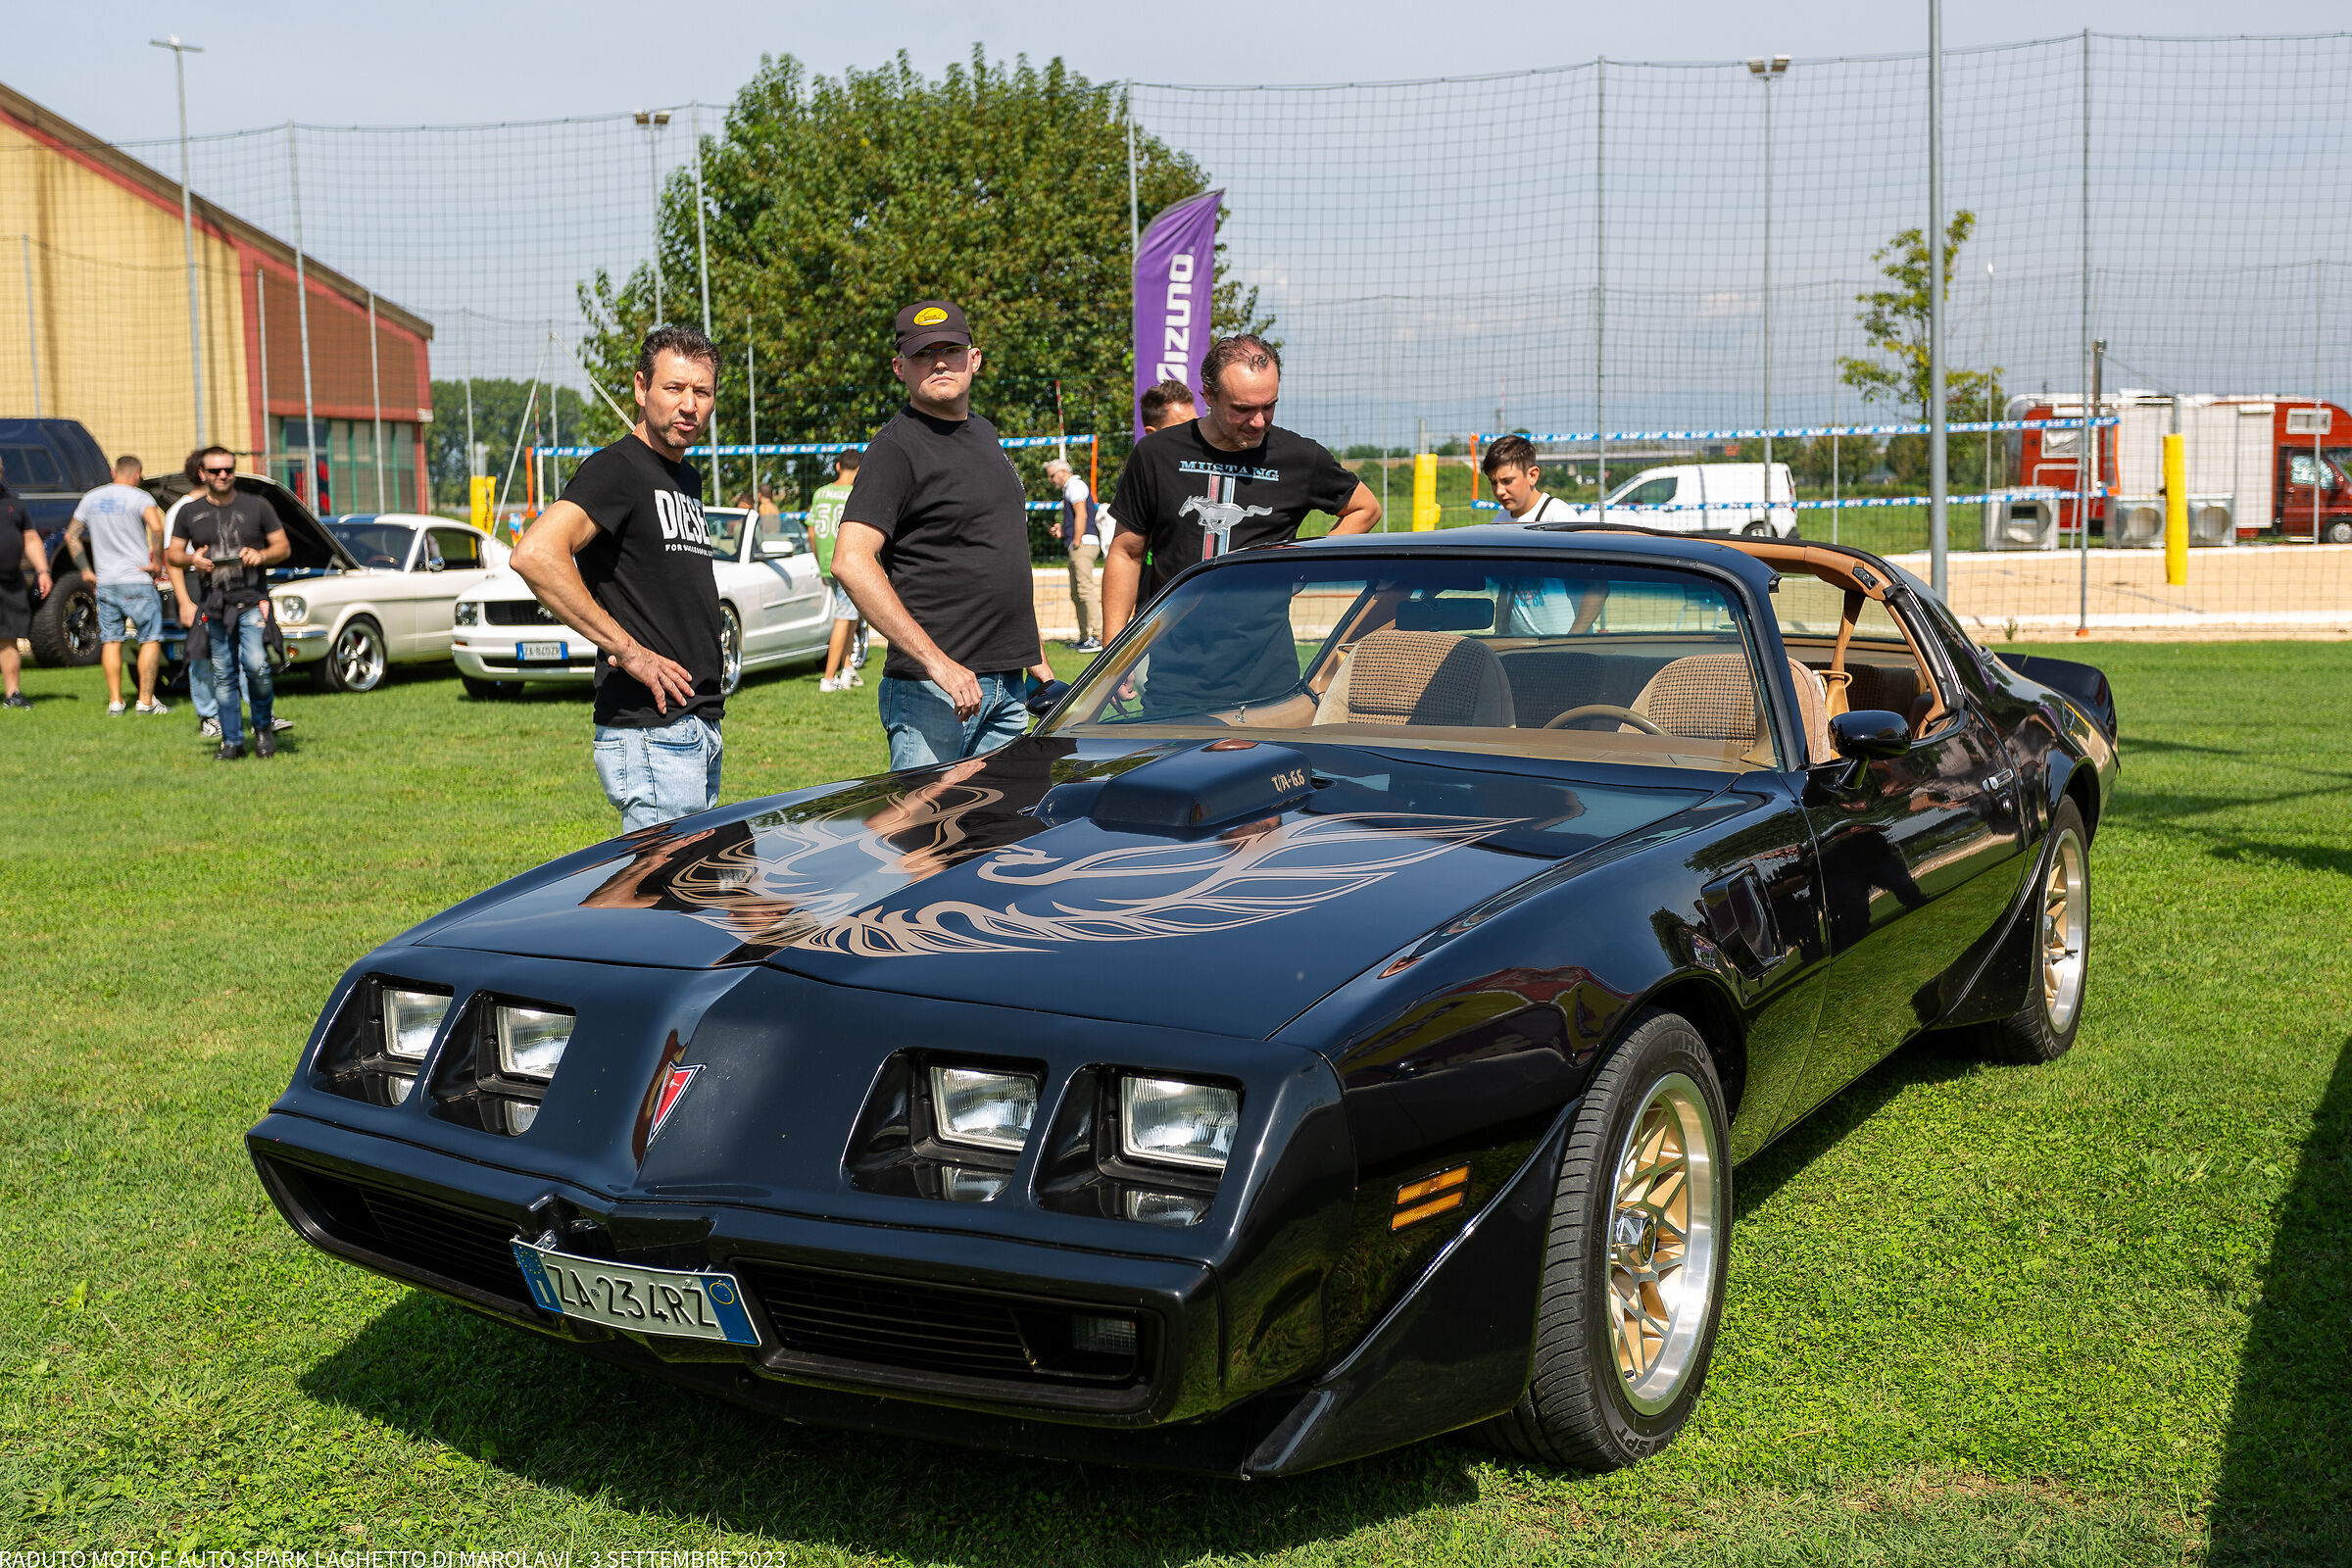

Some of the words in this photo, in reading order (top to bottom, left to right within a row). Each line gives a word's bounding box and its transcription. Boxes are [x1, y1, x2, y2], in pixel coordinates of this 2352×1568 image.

[1179, 460, 1280, 479] MUSTANG
[655, 489, 711, 546] DIESE
[664, 543, 683, 552] FOR
[545, 1263, 599, 1311] ZA
[596, 1274, 719, 1329] 234RZ
